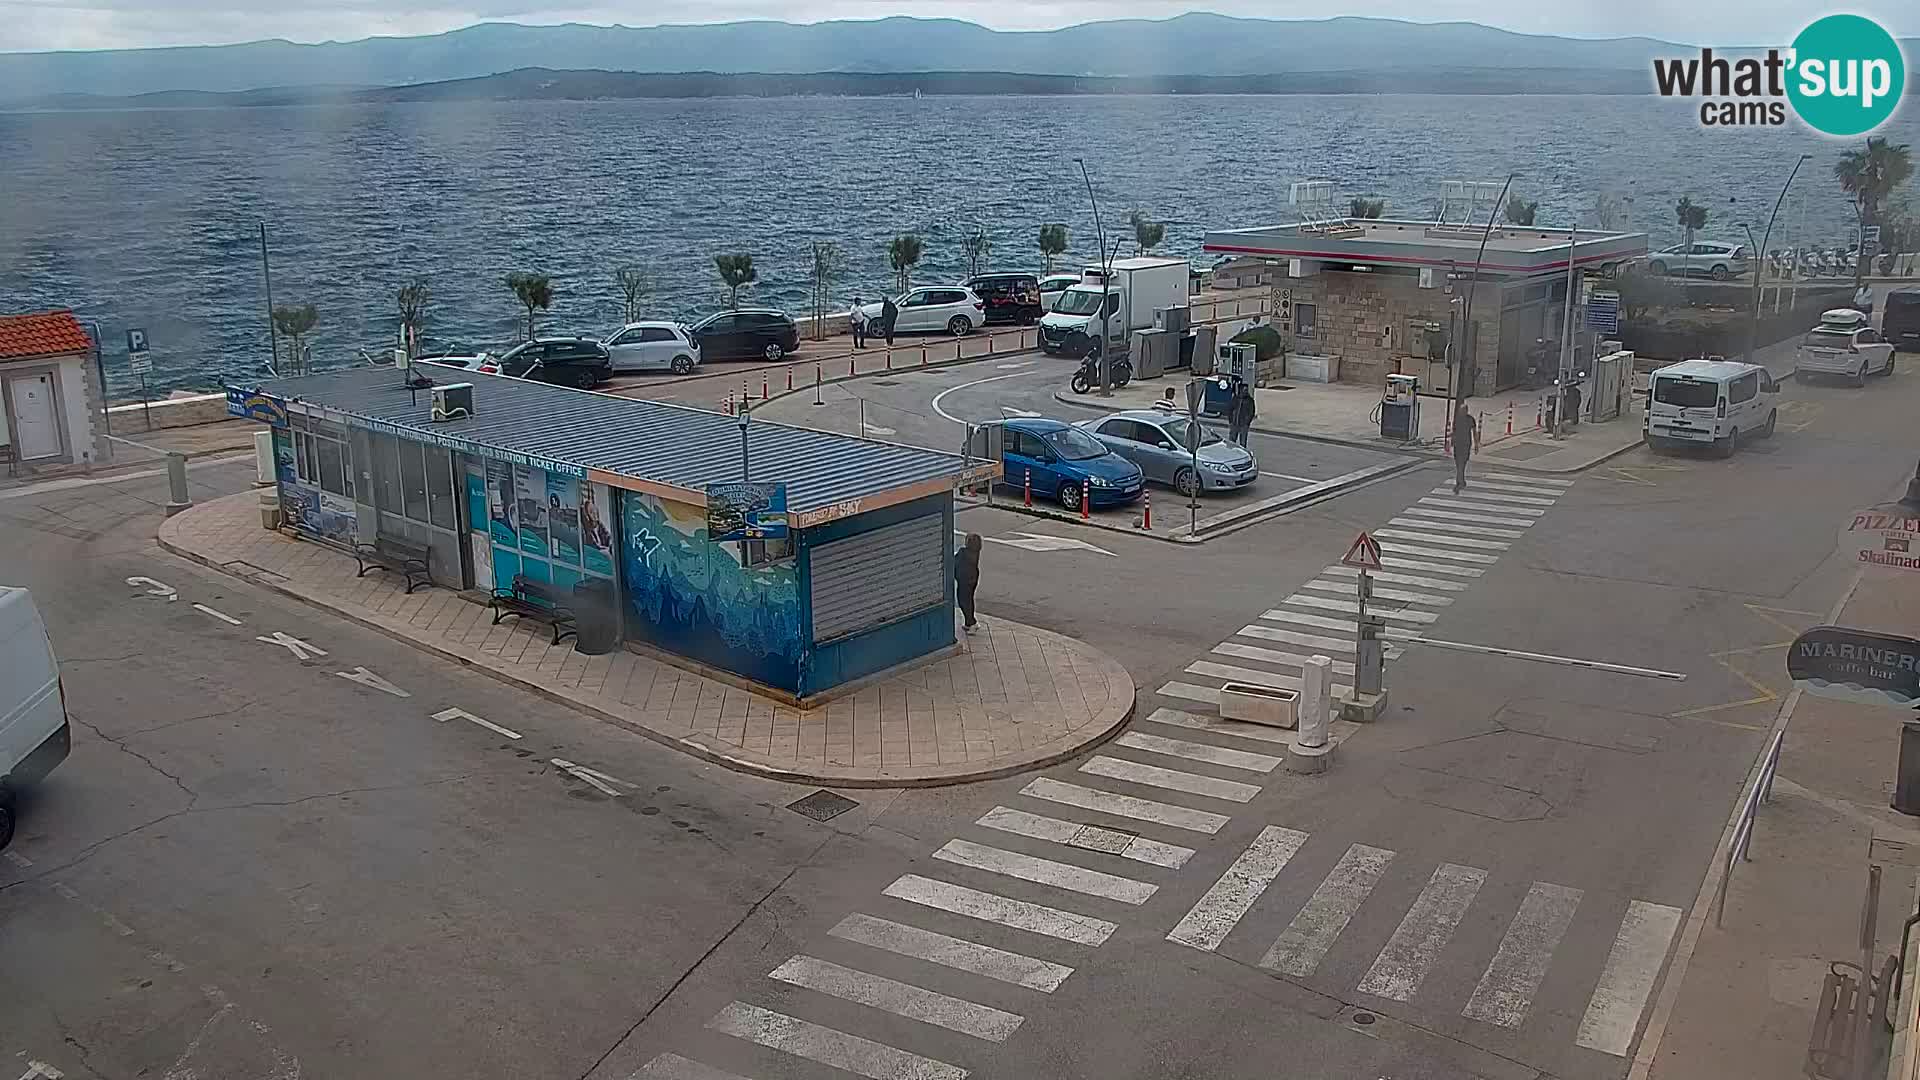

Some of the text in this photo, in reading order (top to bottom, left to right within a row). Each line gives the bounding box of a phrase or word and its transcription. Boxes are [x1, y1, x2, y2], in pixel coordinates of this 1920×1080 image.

[131, 331, 144, 349] P
[439, 437, 470, 452] POSTAJA
[479, 446, 585, 477] BUS STATION TICKET OFFICE
[1871, 666, 1898, 681] bar
